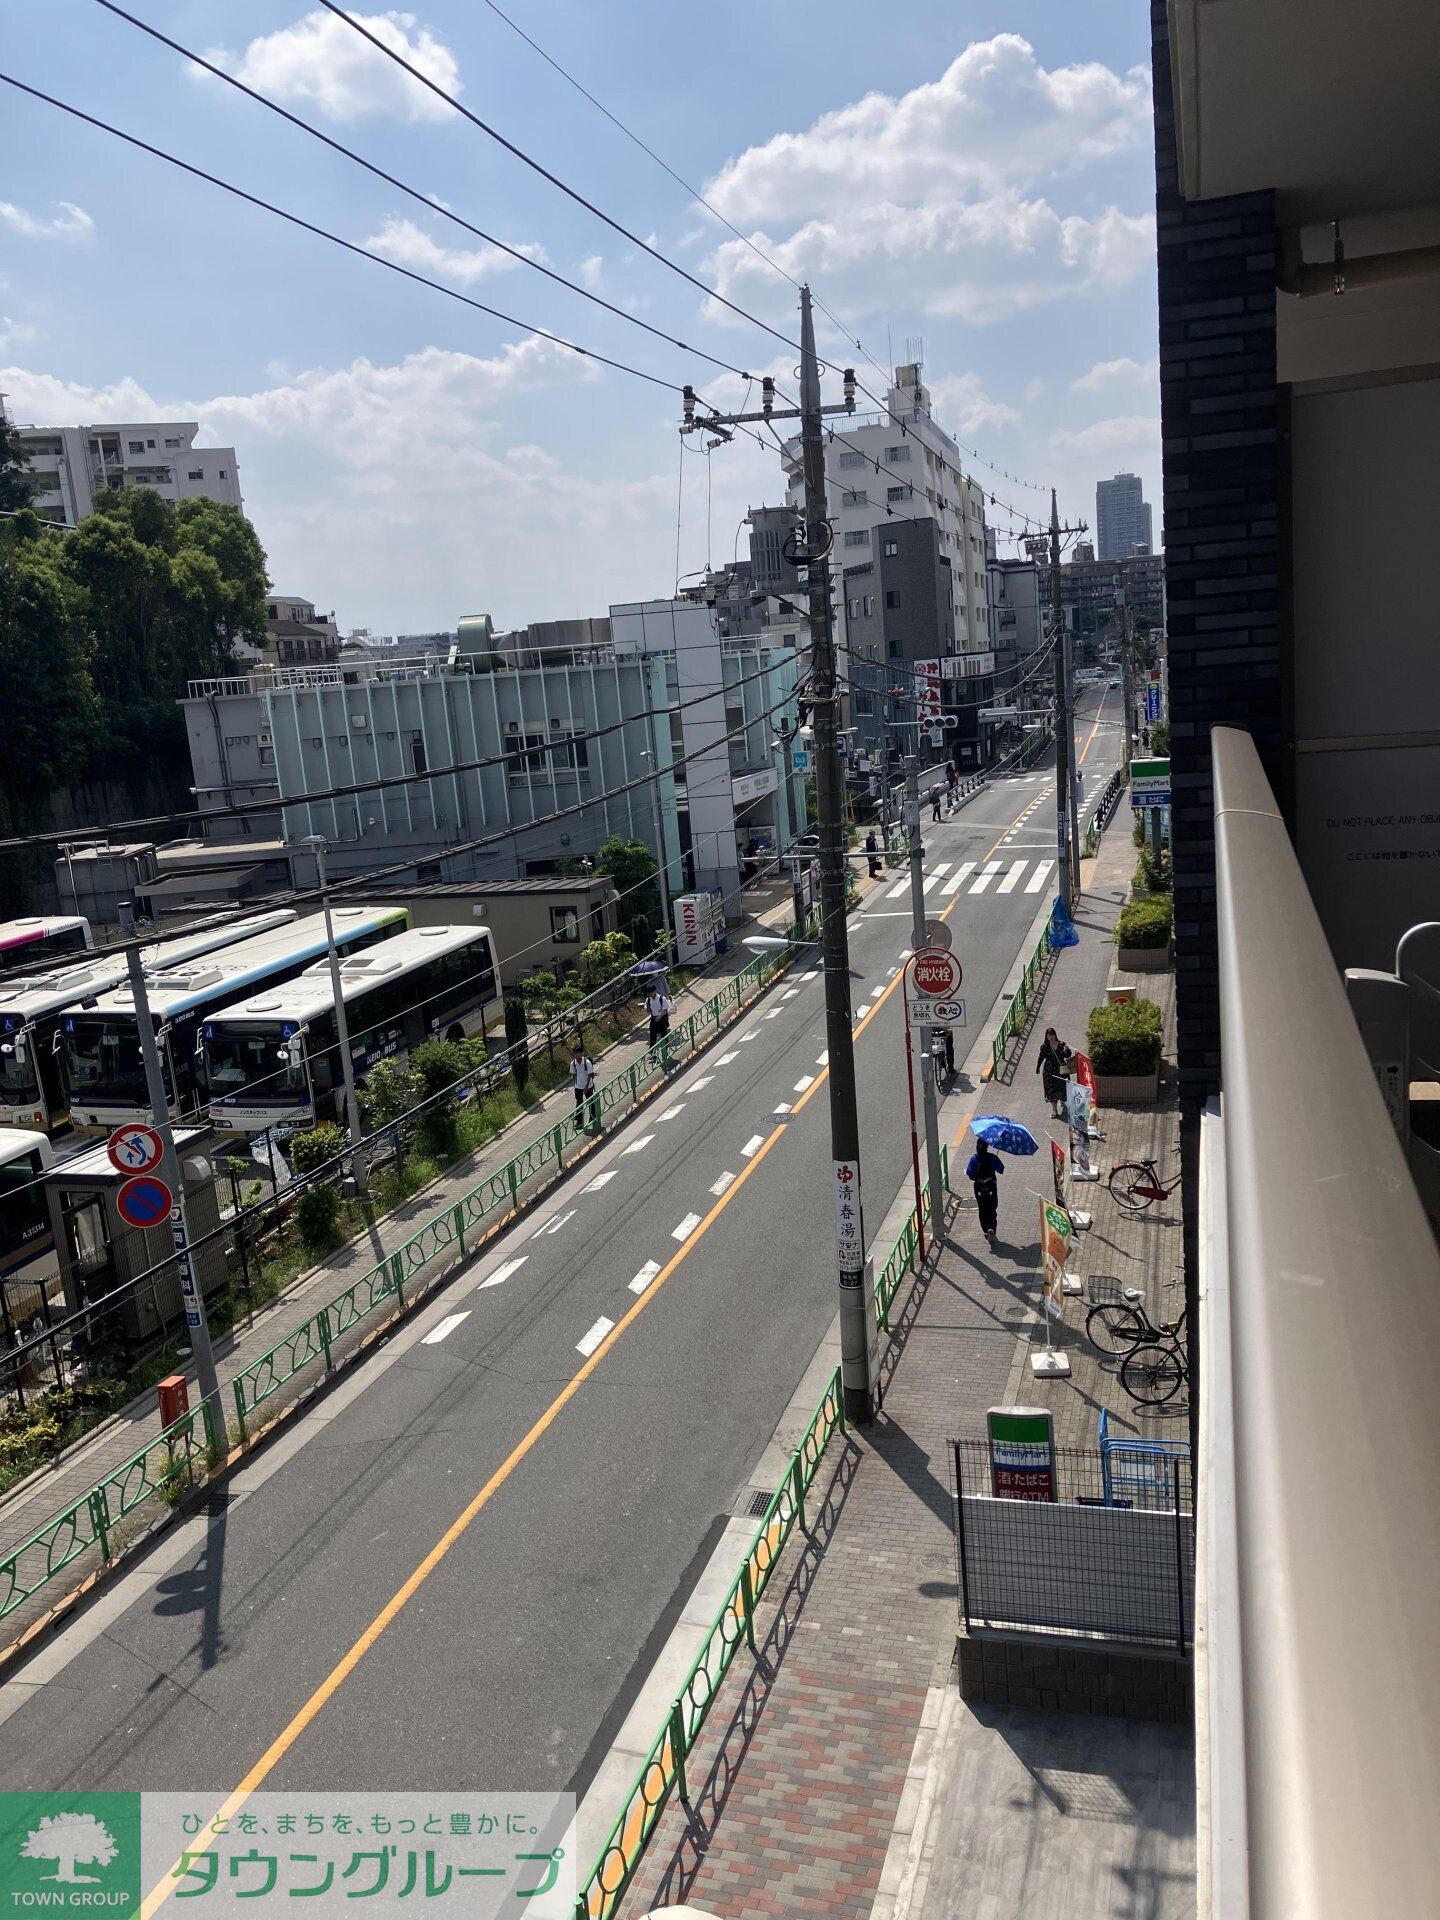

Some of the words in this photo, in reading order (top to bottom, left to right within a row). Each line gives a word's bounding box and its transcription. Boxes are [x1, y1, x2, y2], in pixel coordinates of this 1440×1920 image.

[1151, 690, 1159, 719] クリーニング
[1132, 780, 1169, 788] FamilyMart
[1148, 796, 1165, 804] たばこ
[1327, 818, 1341, 828] DO
[1343, 817, 1362, 827] NOT
[1364, 816, 1394, 826] PLACE
[1399, 815, 1417, 824] ANY
[917, 966, 951, 982] 消火栓
[937, 1006, 958, 1015] 救心
[384, 1041, 397, 1055] BUS
[838, 1184, 856, 1239] 清春湯
[994, 1449, 1047, 1459] FamilyMart
